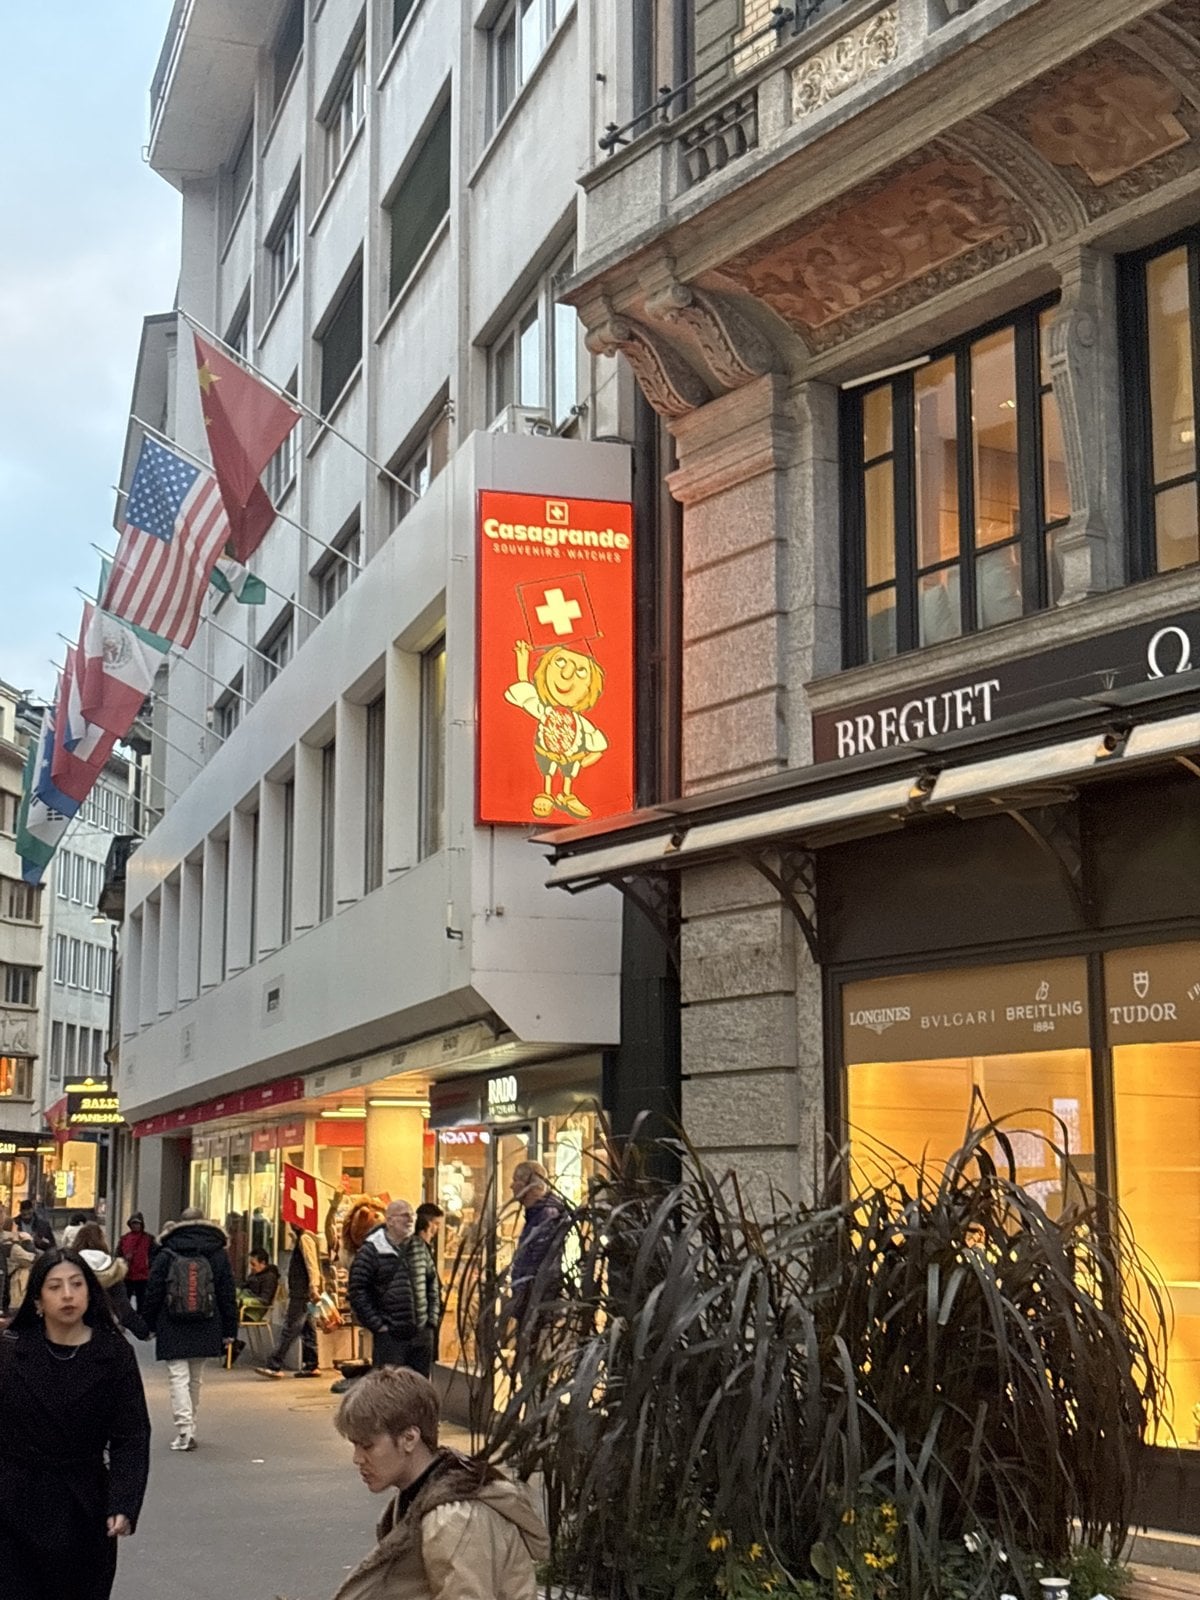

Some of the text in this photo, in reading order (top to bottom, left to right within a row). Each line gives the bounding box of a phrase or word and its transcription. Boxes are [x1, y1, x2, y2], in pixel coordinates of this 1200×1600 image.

[483, 518, 631, 549] Casagrande
[492, 542, 622, 563] SOUVENIRS WATCHES
[834, 678, 1000, 759] BREGUET
[849, 1006, 911, 1026] LONGINES
[920, 1009, 995, 1029] BVLGARI
[1006, 1001, 1083, 1021] BREITLING
[1109, 1003, 1177, 1025] TUDOR
[1033, 1021, 1055, 1032] 1884
[487, 1075, 518, 1104] RADO
